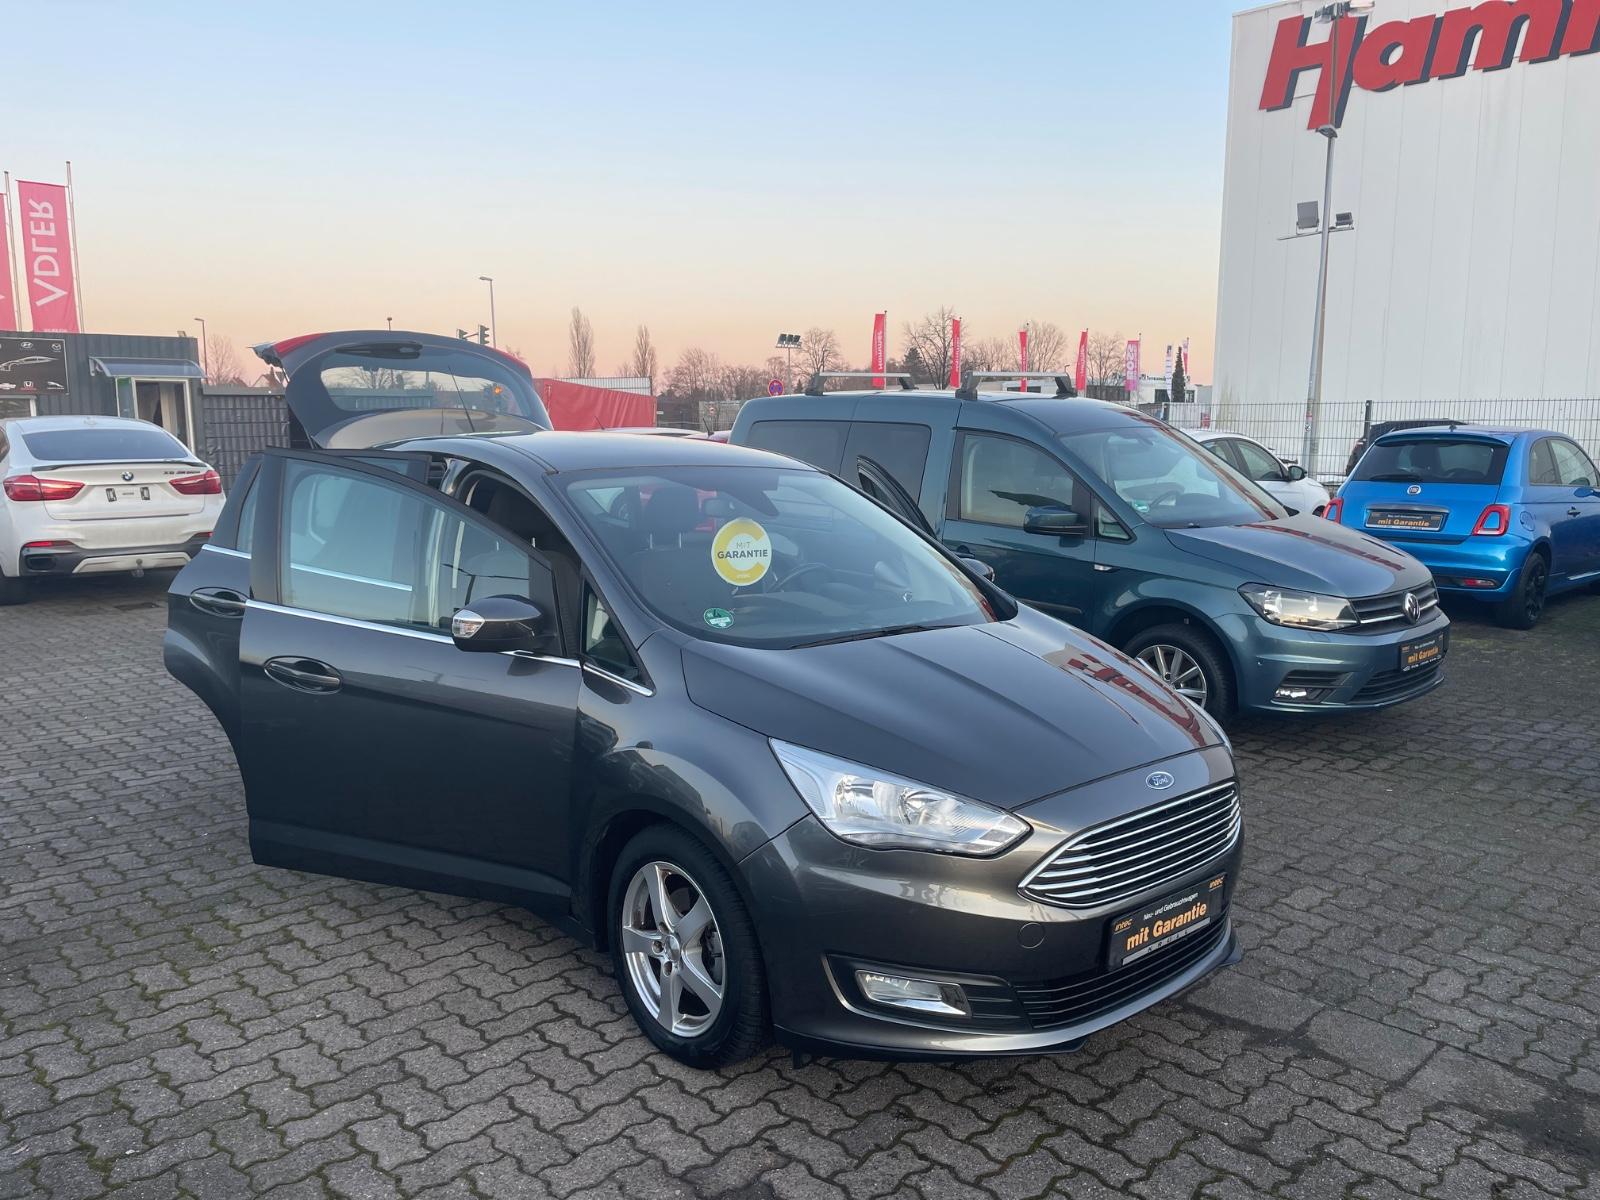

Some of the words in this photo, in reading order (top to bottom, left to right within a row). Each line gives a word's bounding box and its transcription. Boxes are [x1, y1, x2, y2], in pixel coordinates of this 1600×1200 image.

[1393, 518, 1430, 527] Garantie
[717, 549, 769, 559] GARANTIE
[1126, 927, 1149, 950] mit
[1152, 902, 1207, 937] Garantie
